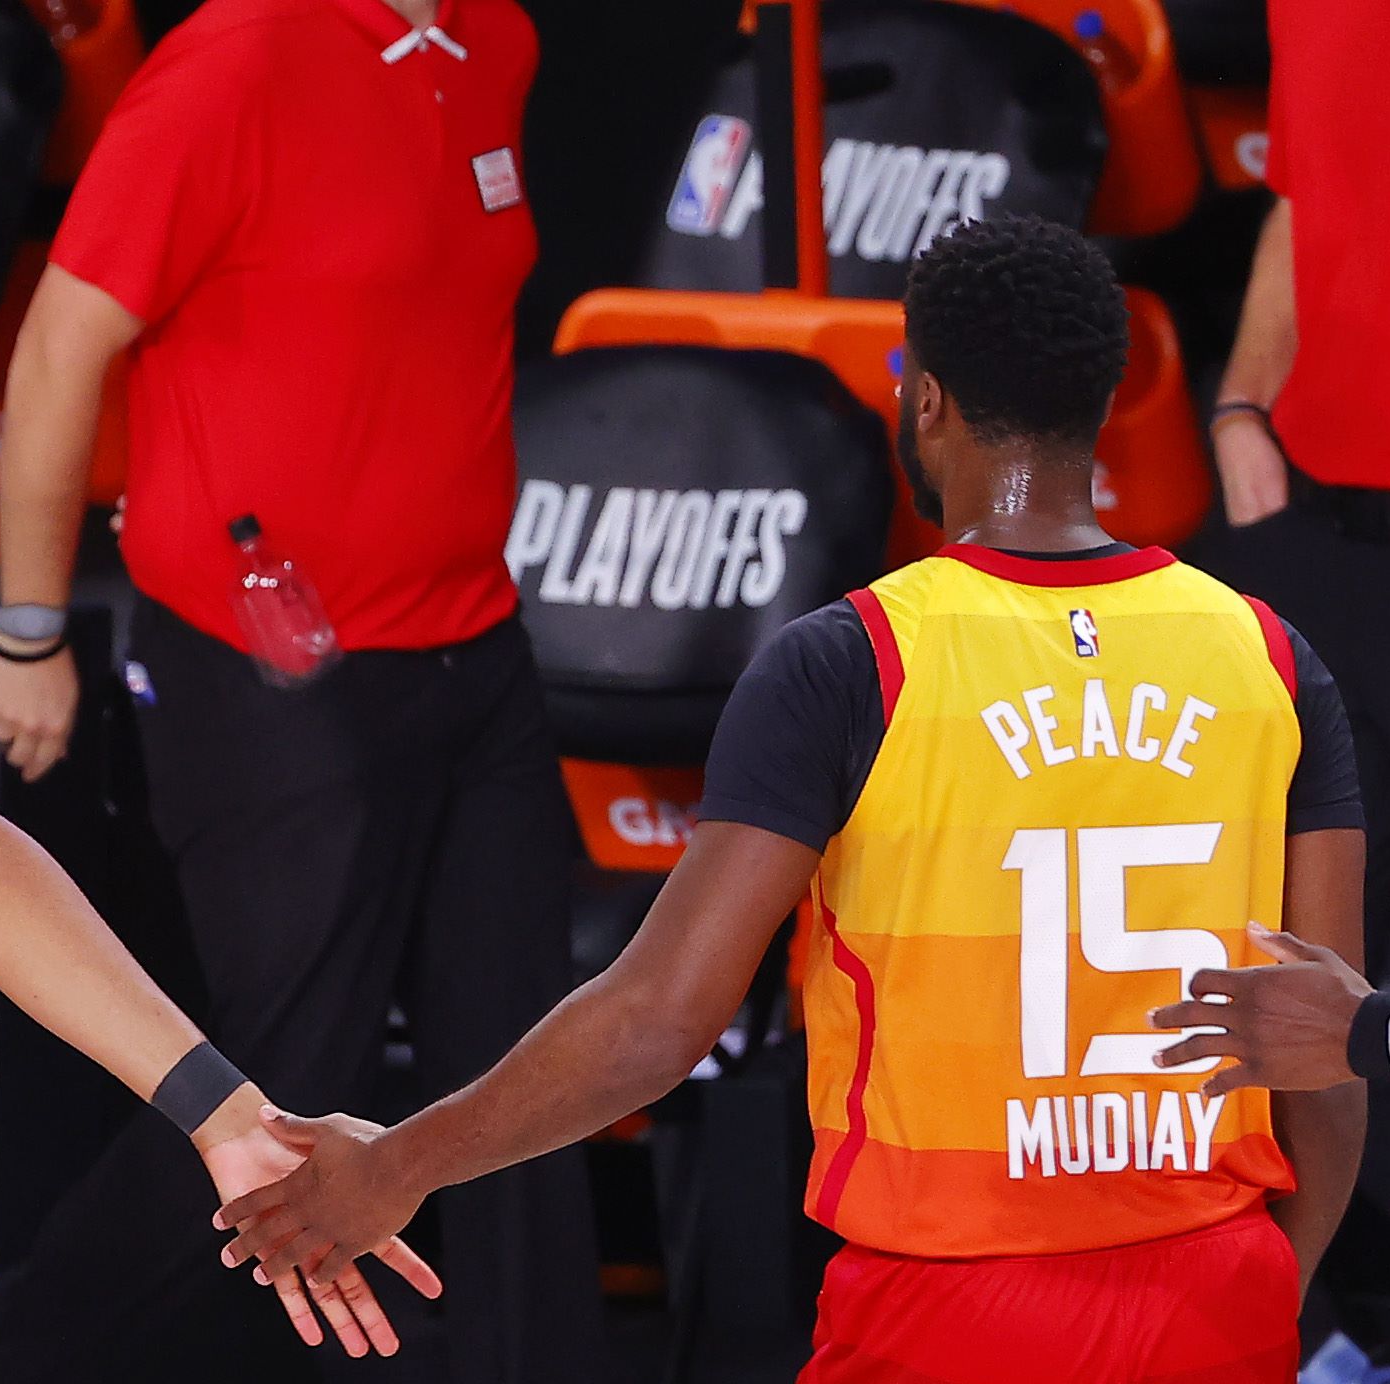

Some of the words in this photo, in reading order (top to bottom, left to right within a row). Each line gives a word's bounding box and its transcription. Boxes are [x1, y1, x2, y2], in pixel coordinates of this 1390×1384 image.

[503, 479, 808, 610] PLAYOFFS
[979, 679, 1218, 779] PEACE
[1000, 822, 1230, 1079] 15
[1005, 1090, 1226, 1181] MUDIAY
